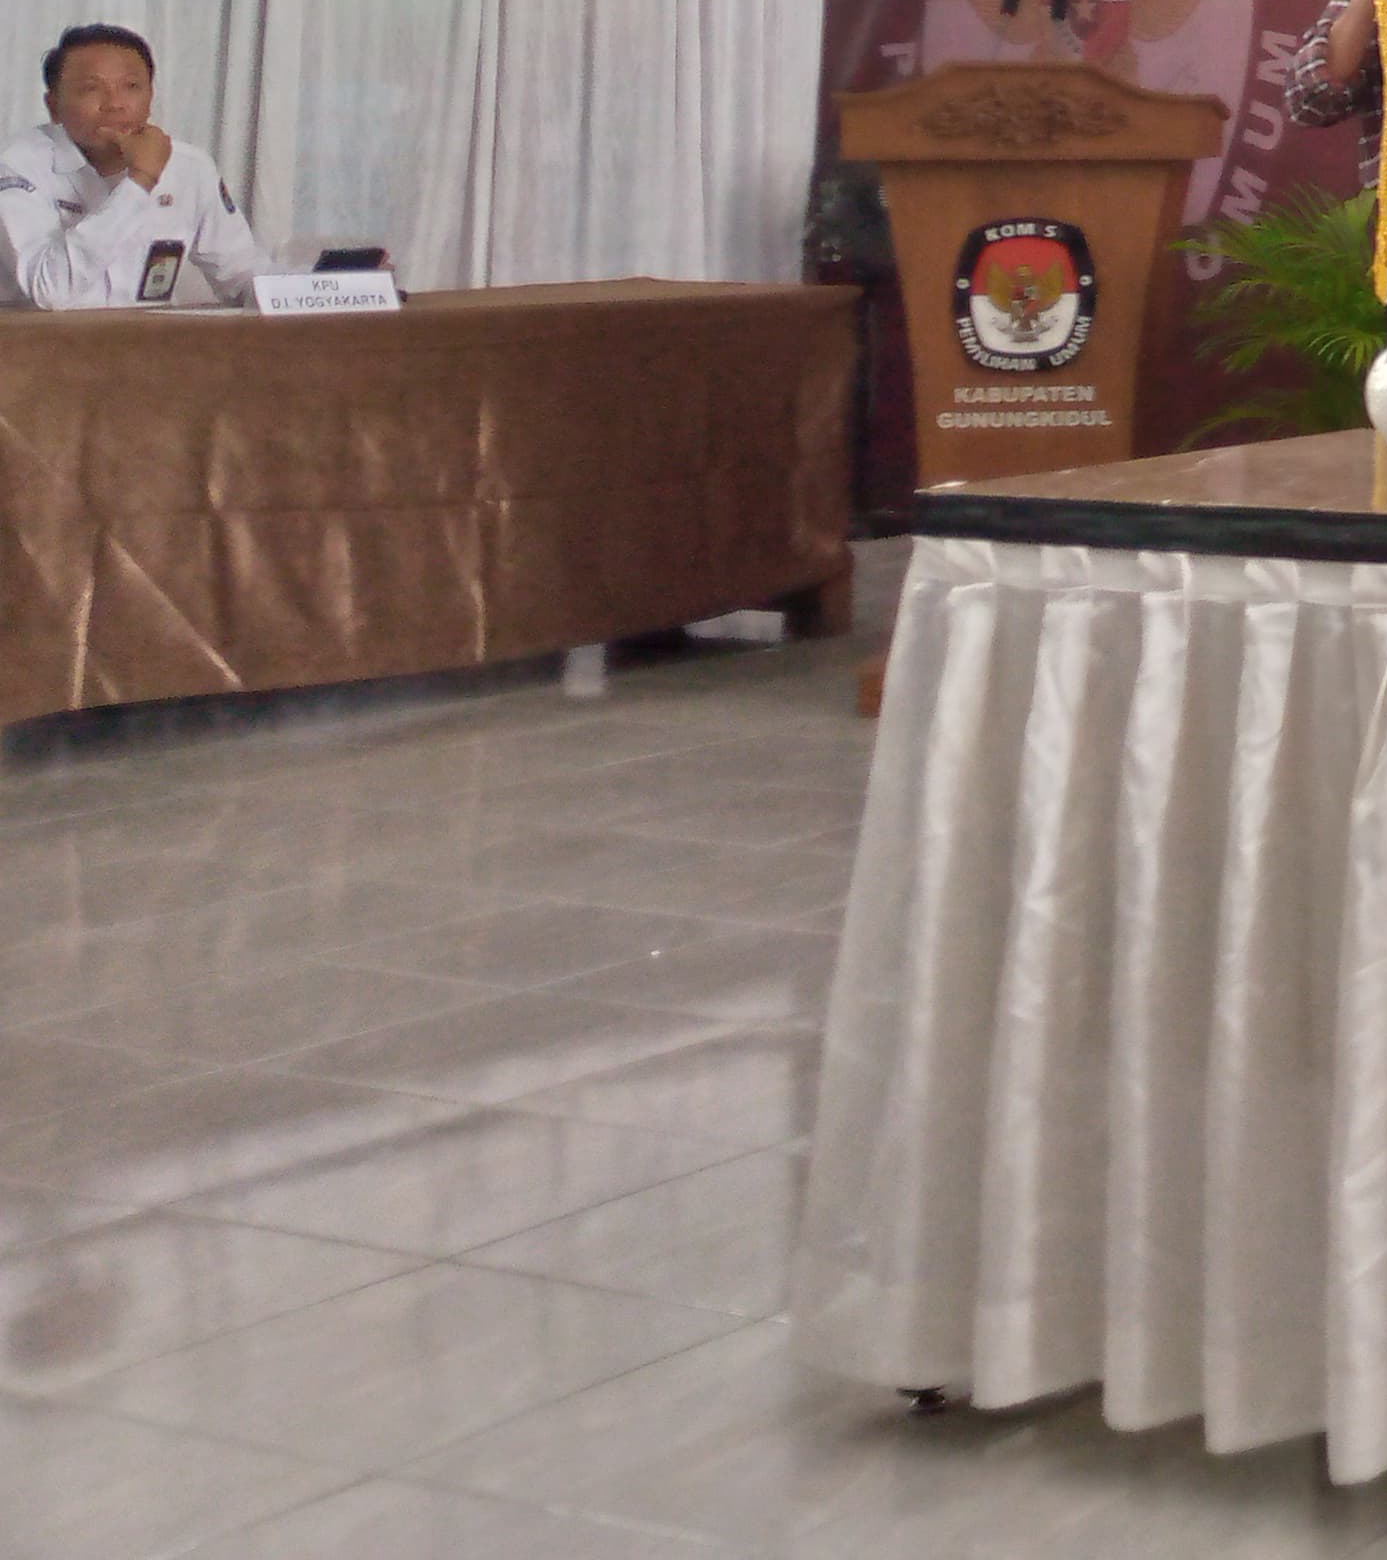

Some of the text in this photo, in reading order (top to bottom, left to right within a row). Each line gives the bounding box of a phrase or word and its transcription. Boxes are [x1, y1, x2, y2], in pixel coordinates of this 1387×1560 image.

[312, 280, 340, 291] KPU
[296, 294, 387, 309] YOGYAKARTA
[954, 386, 1095, 403] KABUPATEN
[936, 410, 1113, 428] GUNUNGKIDUL
